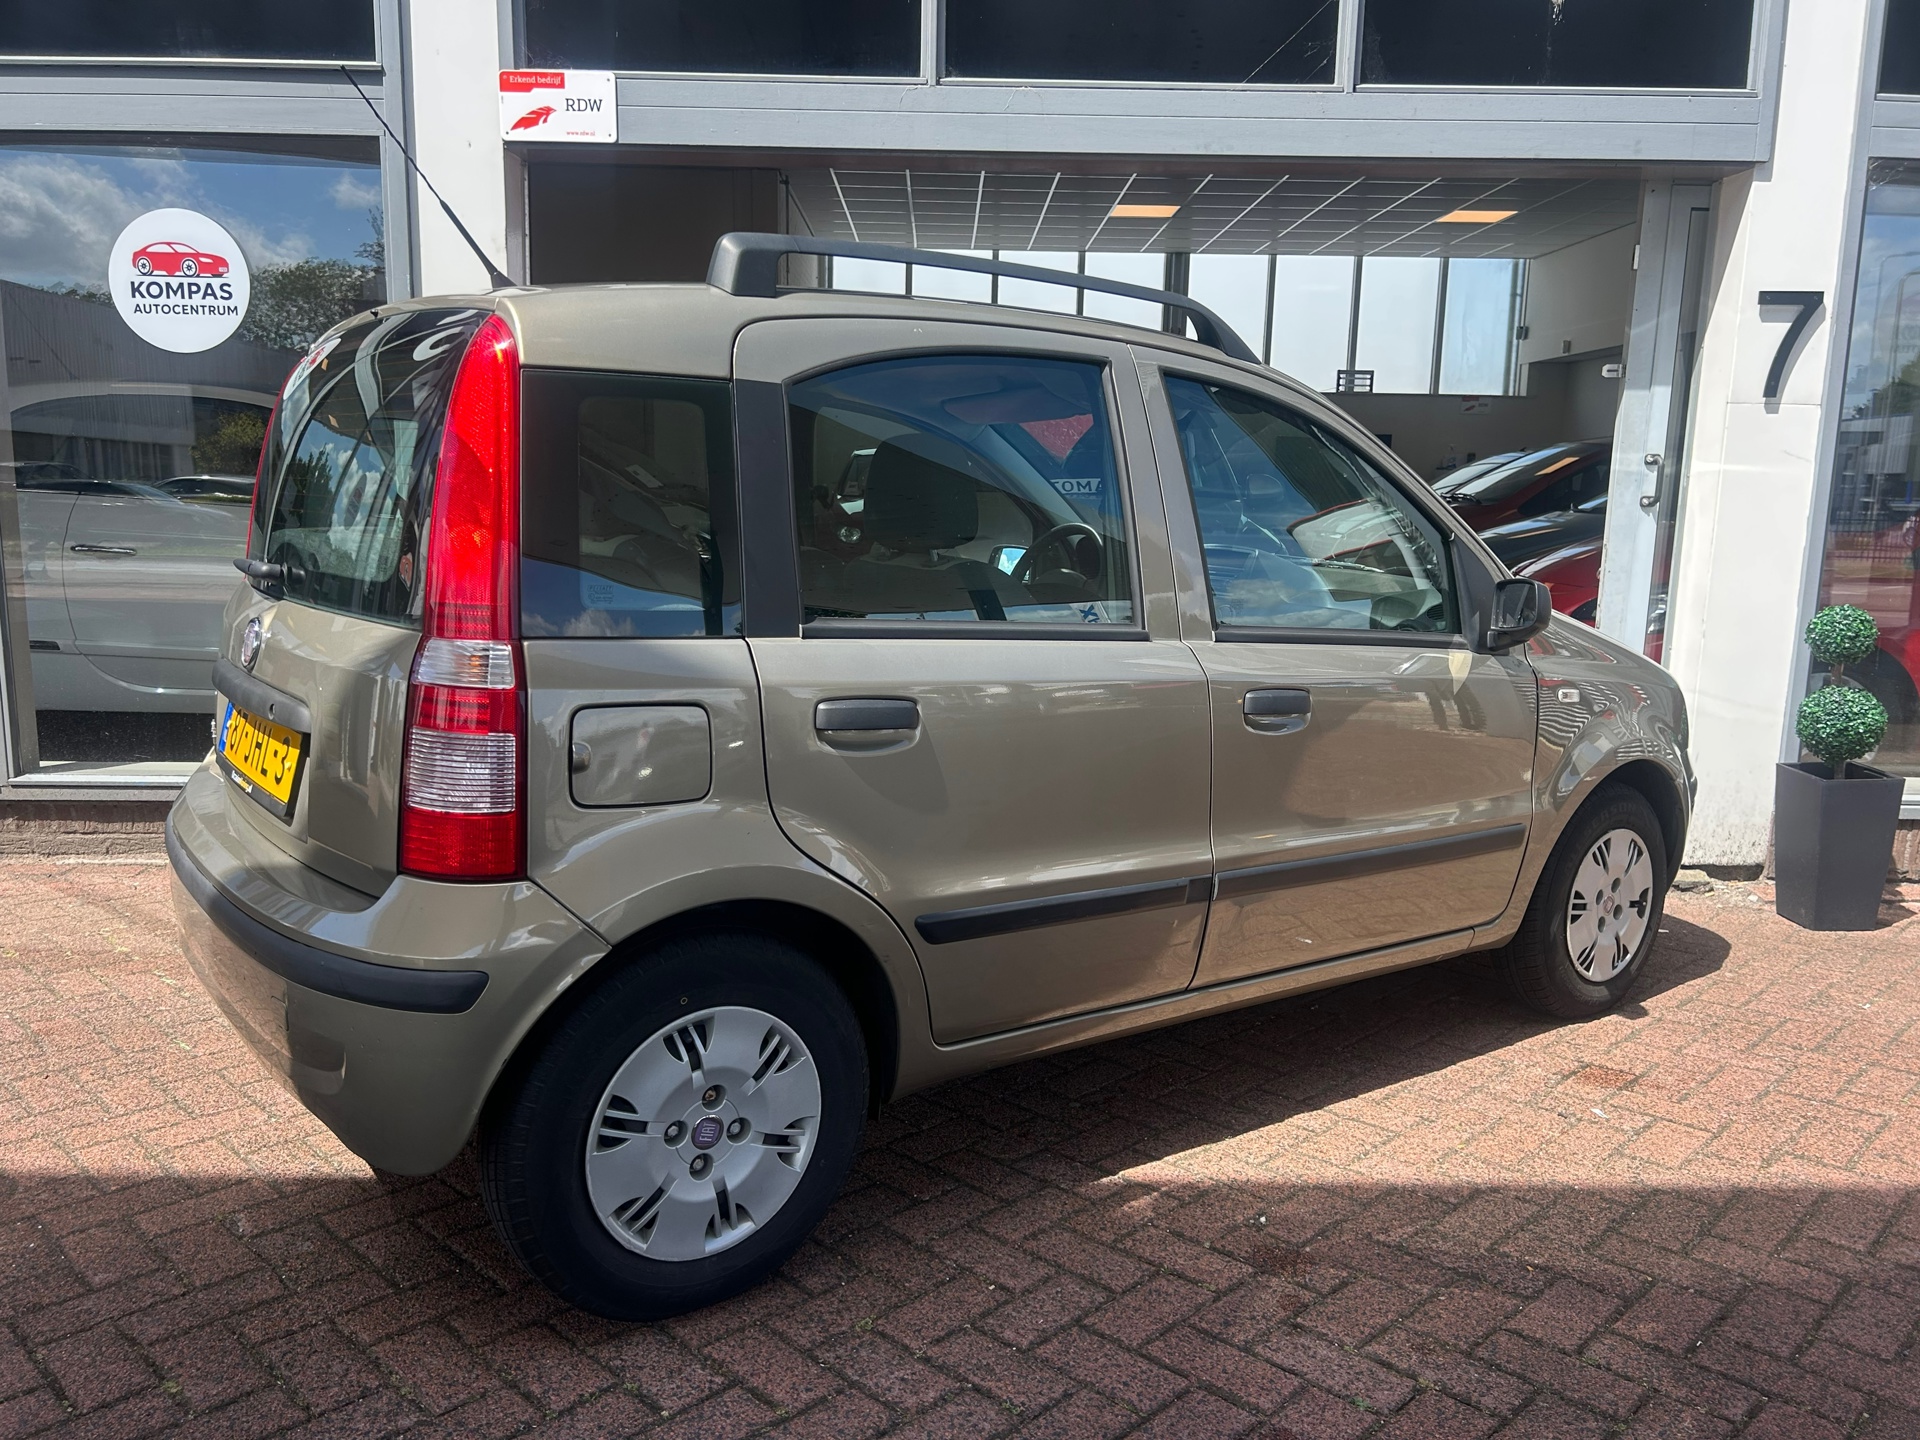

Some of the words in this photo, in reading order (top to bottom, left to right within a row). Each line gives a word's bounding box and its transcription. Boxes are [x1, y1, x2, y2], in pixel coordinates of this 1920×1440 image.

[509, 75, 536, 84] Erkend
[537, 75, 562, 86] bedrijf
[565, 98, 603, 112] RDW
[130, 281, 233, 301] KOMPAS
[133, 303, 239, 316] AUTOCENTRUM
[1757, 290, 1825, 398] 7
[699, 1122, 717, 1142] FIAT
